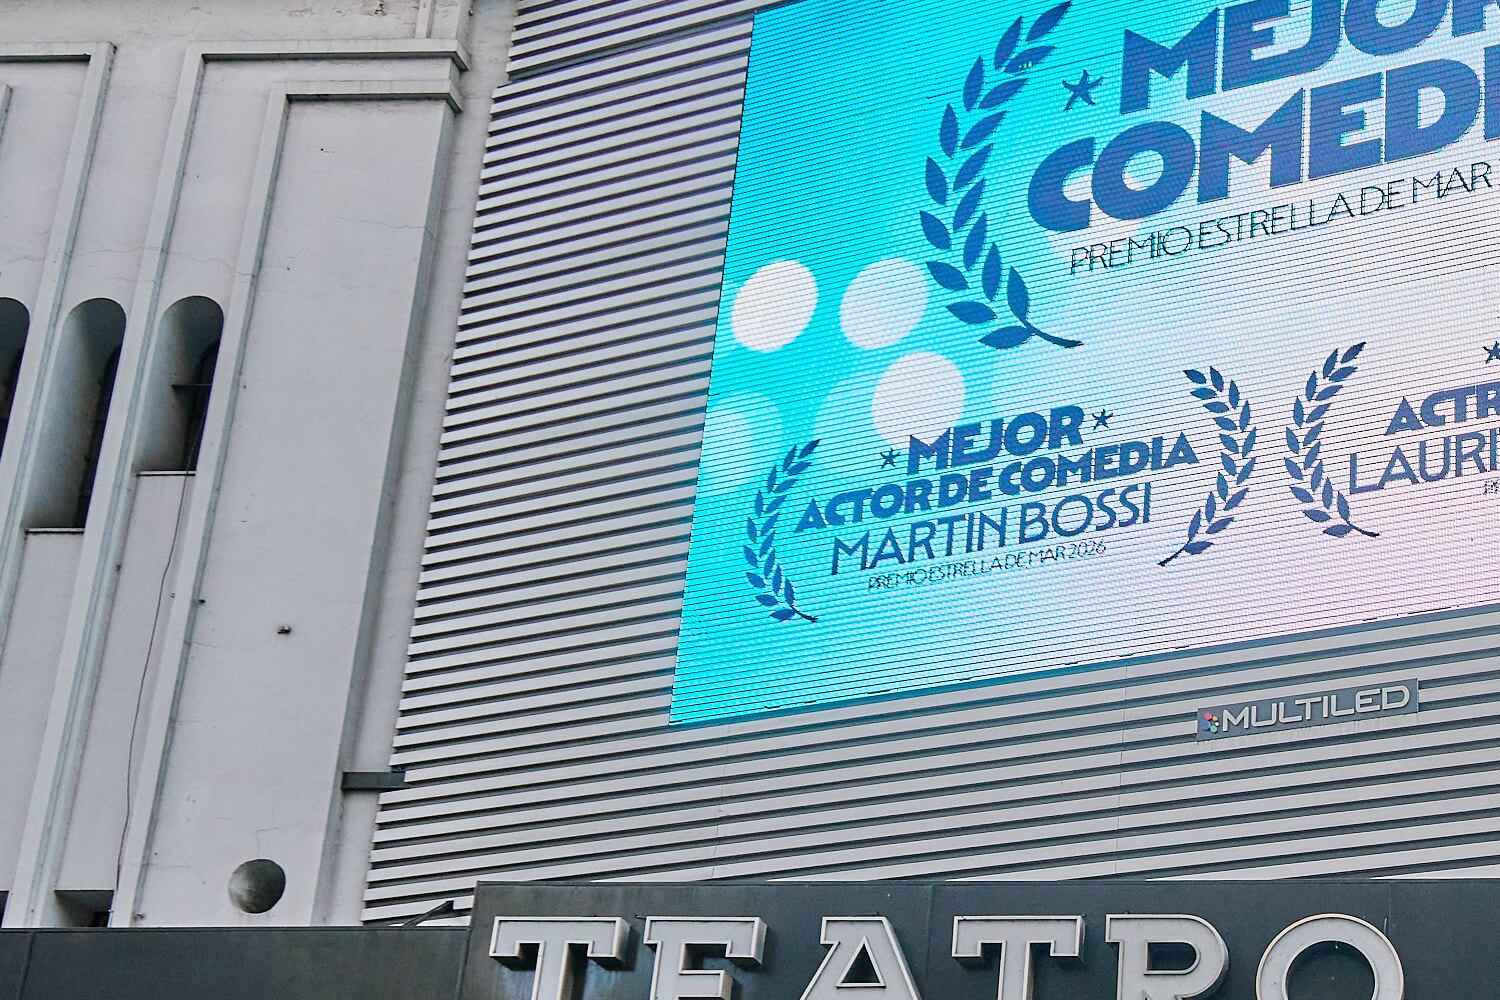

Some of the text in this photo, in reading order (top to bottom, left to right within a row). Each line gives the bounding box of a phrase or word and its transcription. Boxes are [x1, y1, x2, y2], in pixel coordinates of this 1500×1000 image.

[1070, 225, 1192, 275] PREMIO
[1200, 192, 1354, 250] ESTRELLA
[1361, 179, 1407, 215] DE
[1412, 161, 1492, 204] MAR
[906, 404, 1086, 475] MEJOR
[794, 431, 1199, 533] ACTOR DE COMEDIA
[830, 482, 1151, 575] MARTIN BOSSI
[868, 568, 927, 590] PREMIO
[928, 556, 1001, 582] ESTRELLA
[1028, 545, 1064, 569] MAR
[1066, 539, 1106, 560] 2026
[1222, 685, 1410, 732] MULTILED
